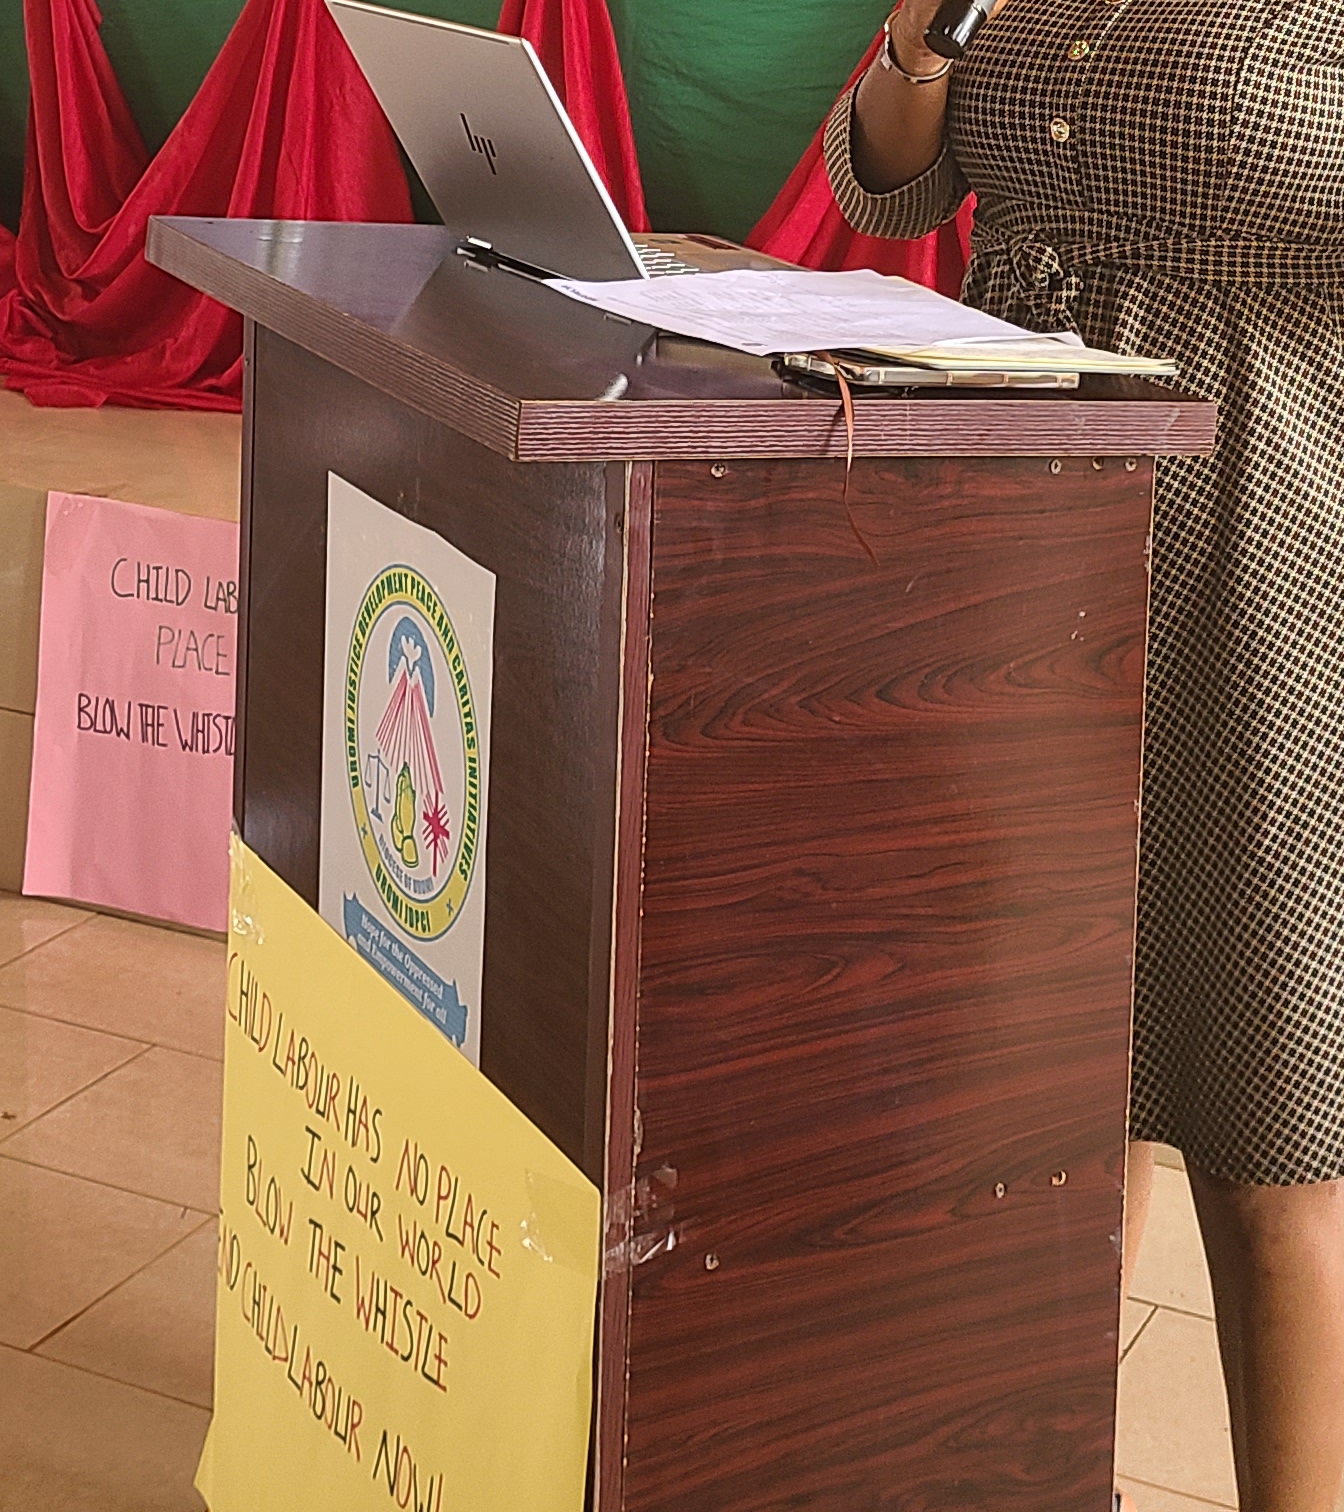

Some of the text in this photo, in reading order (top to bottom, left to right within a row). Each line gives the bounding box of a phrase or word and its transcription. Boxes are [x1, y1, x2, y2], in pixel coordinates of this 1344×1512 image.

[111, 558, 193, 608] CHILD
[357, 571, 410, 638] DEVELOPMENT
[410, 576, 439, 621] PEACE
[156, 624, 231, 676] PLACE
[435, 613, 456, 655] AND
[347, 630, 364, 716] JUSTICE
[451, 654, 477, 751] CARITAS
[77, 692, 169, 748] BLOW THE
[458, 755, 480, 882] INITIATIVES
[228, 951, 502, 1279] CHILD LABOUR HAS NO PLACE
[300, 1125, 482, 1320] IN OUR WORLD
[246, 1134, 448, 1393] BLOW THE WHISTLE
